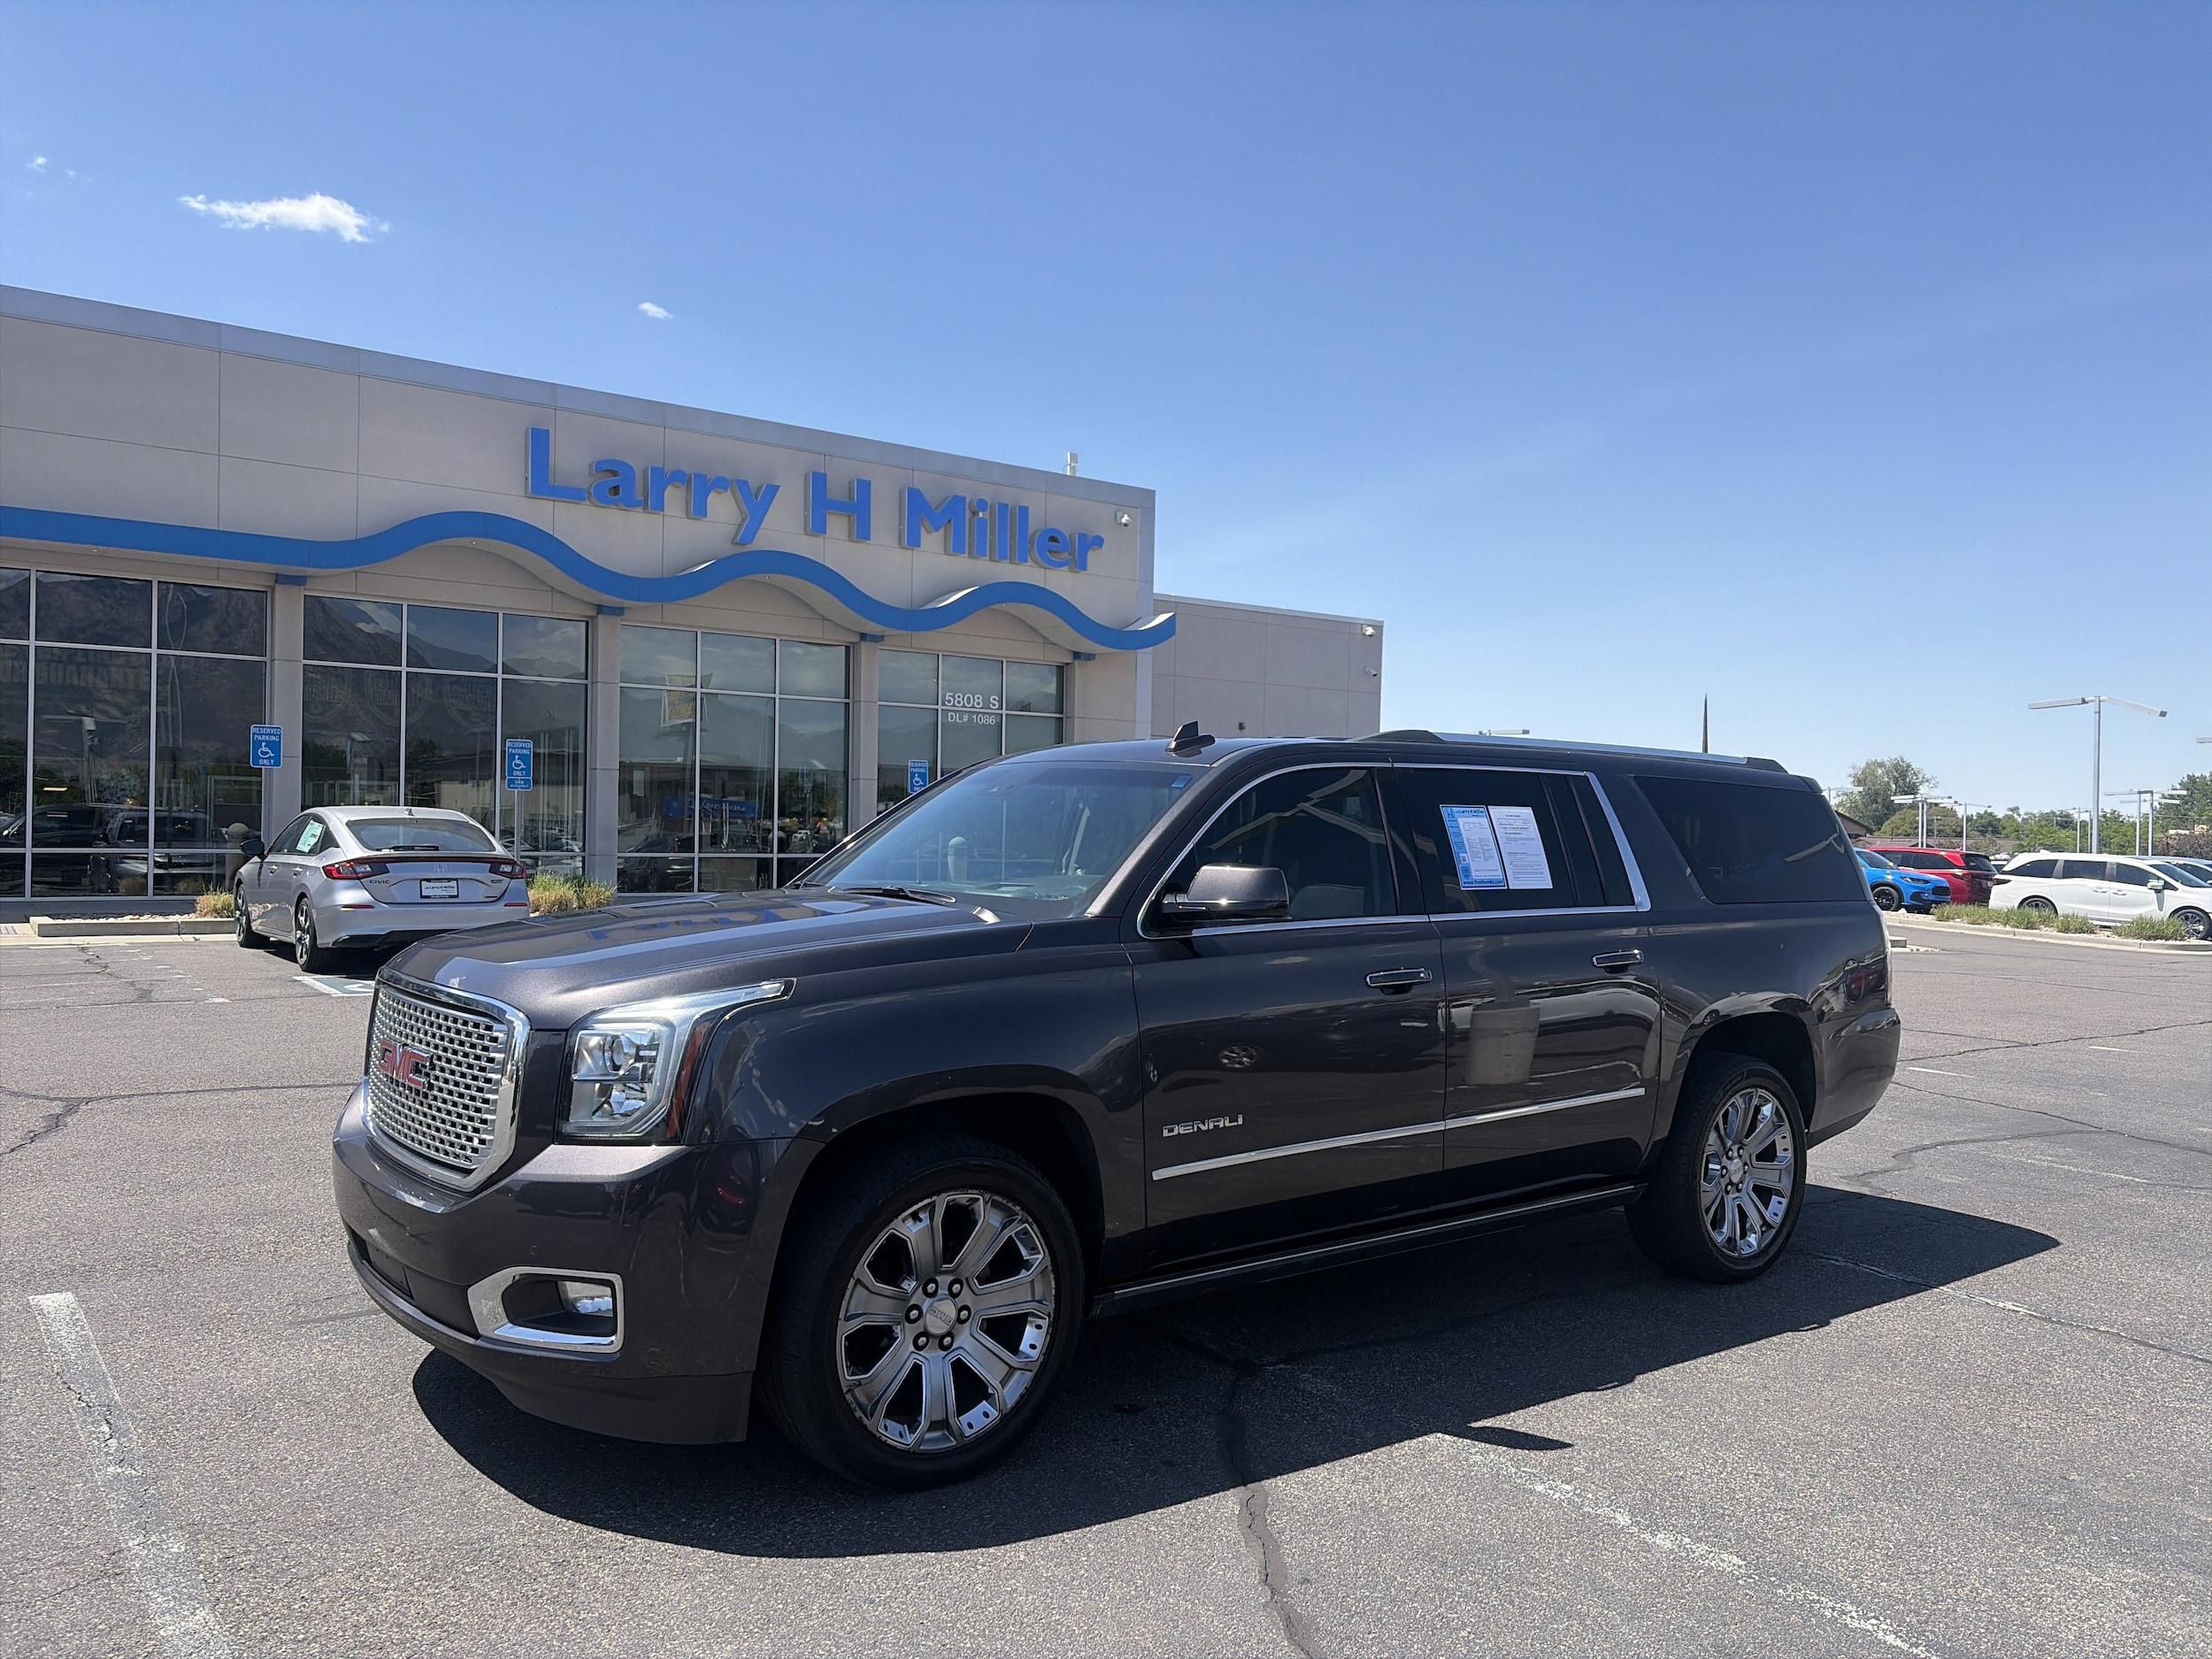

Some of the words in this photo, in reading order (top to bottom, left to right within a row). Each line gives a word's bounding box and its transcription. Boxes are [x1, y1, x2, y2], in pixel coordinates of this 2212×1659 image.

[525, 426, 780, 545] Larry
[804, 471, 872, 541] H
[899, 487, 1105, 572] Miller
[945, 692, 983, 708] 5808
[989, 695, 999, 710] S
[948, 711, 969, 723] DL#
[972, 714, 995, 726] 1086
[379, 1039, 430, 1090] GMC
[1162, 1114, 1244, 1138] DENALI
